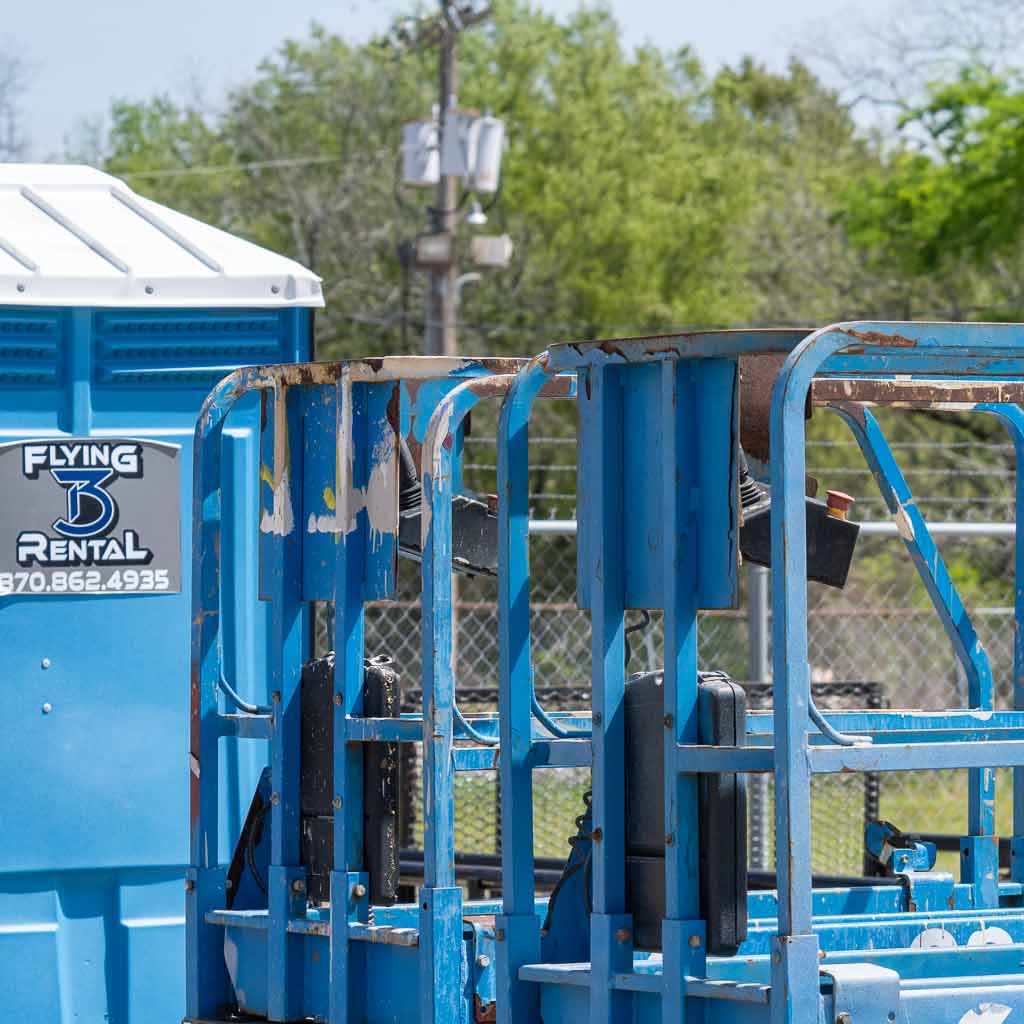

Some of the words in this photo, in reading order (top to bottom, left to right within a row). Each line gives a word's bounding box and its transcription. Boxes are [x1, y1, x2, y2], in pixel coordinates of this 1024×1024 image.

[24, 444, 141, 477] FLYING
[50, 468, 117, 537] 3
[18, 530, 150, 564] RENTAL
